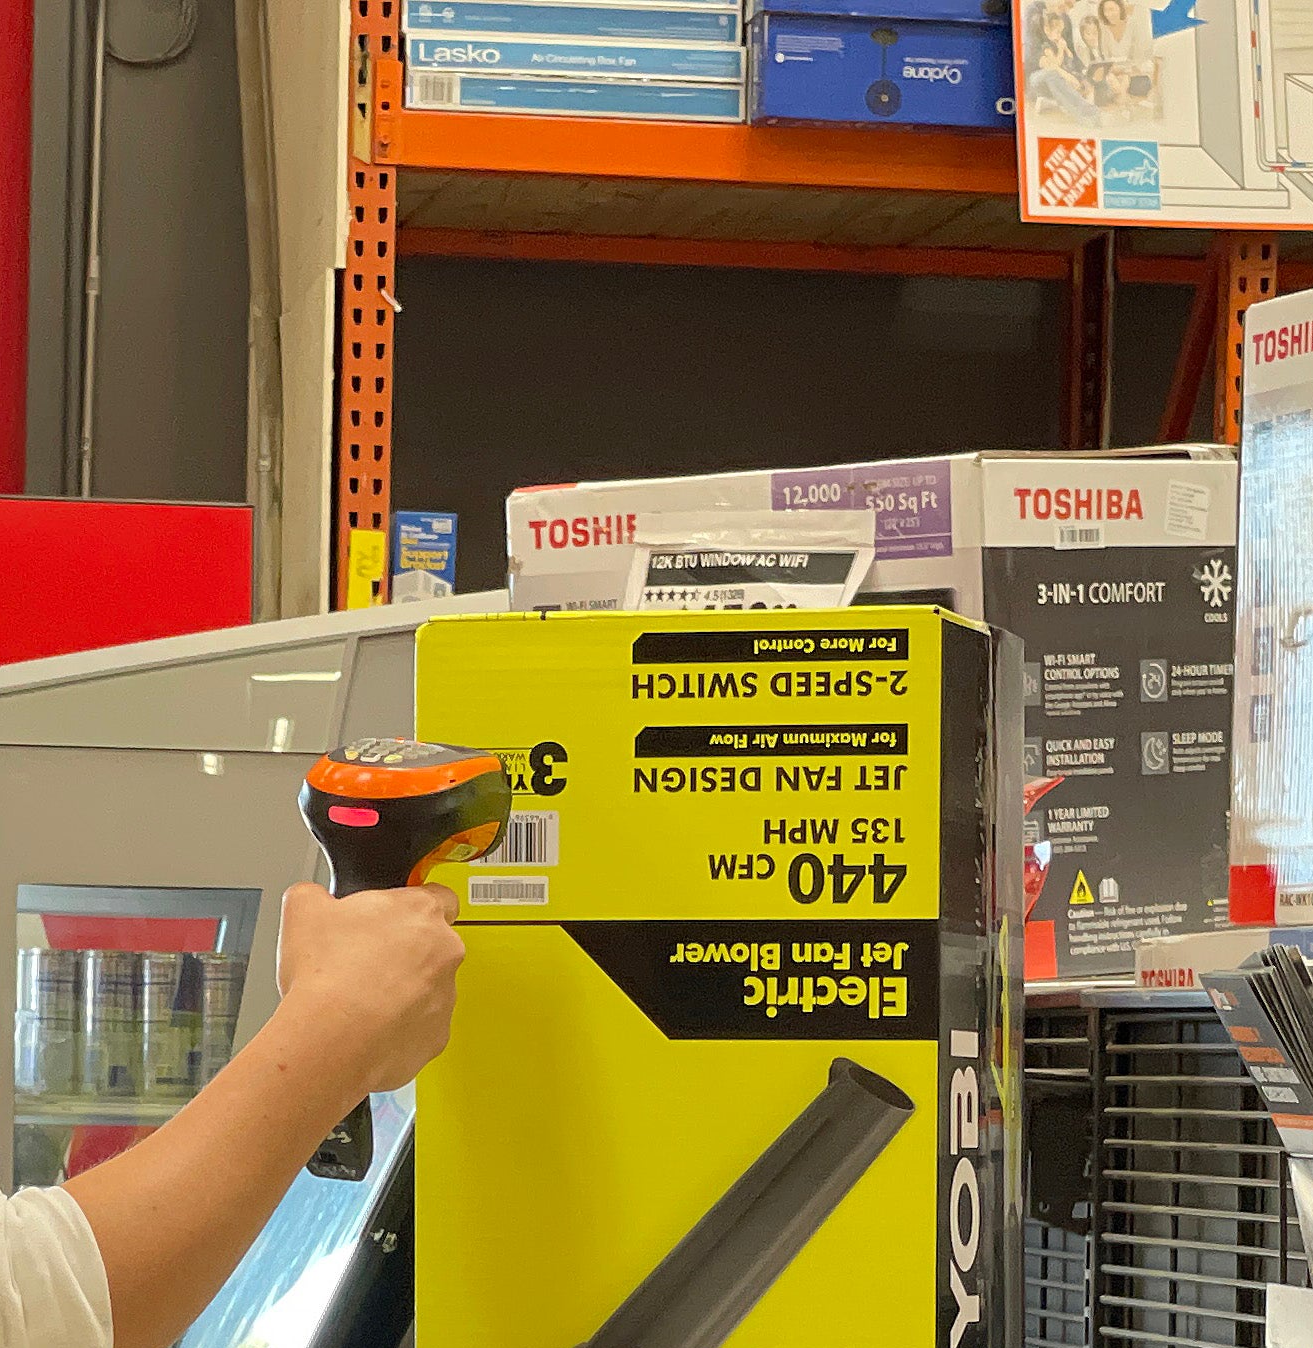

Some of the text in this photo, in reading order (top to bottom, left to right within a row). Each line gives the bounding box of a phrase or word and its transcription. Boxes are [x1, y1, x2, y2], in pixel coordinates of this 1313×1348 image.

[418, 44, 500, 64] Lasko
[903, 65, 961, 84] Cyclone
[783, 483, 841, 505] 12,000
[865, 492, 937, 513] 550 Sq Ft
[1014, 488, 1143, 521] TOSHIBA
[651, 553, 807, 569] 12K BTU WINDOW AC WIFI
[1038, 582, 1165, 604] 3-IN-1 COMFORT
[754, 638, 897, 654] For More Control
[1044, 654, 1095, 666] WI-FI SMART
[1045, 667, 1119, 680] CONTROL OPTIONS
[631, 670, 908, 699] 2-SPEED SWITCH
[709, 732, 897, 749] for Maximum Air Flow
[1046, 738, 1115, 750] QUICK EASY
[1173, 732, 1223, 745] SLEEP MODE
[1047, 752, 1104, 765] INSTALLATION
[530, 742, 567, 796] 3
[634, 765, 907, 793] JET FAN DESIGN
[1054, 807, 1109, 820] YEAR LIMITED
[763, 818, 906, 844] 135 MPH
[1048, 821, 1093, 833] WARRANTY
[709, 853, 908, 905] 440 CFM
[670, 943, 909, 972] Jet Fan Blower
[744, 976, 907, 1019] Electric
